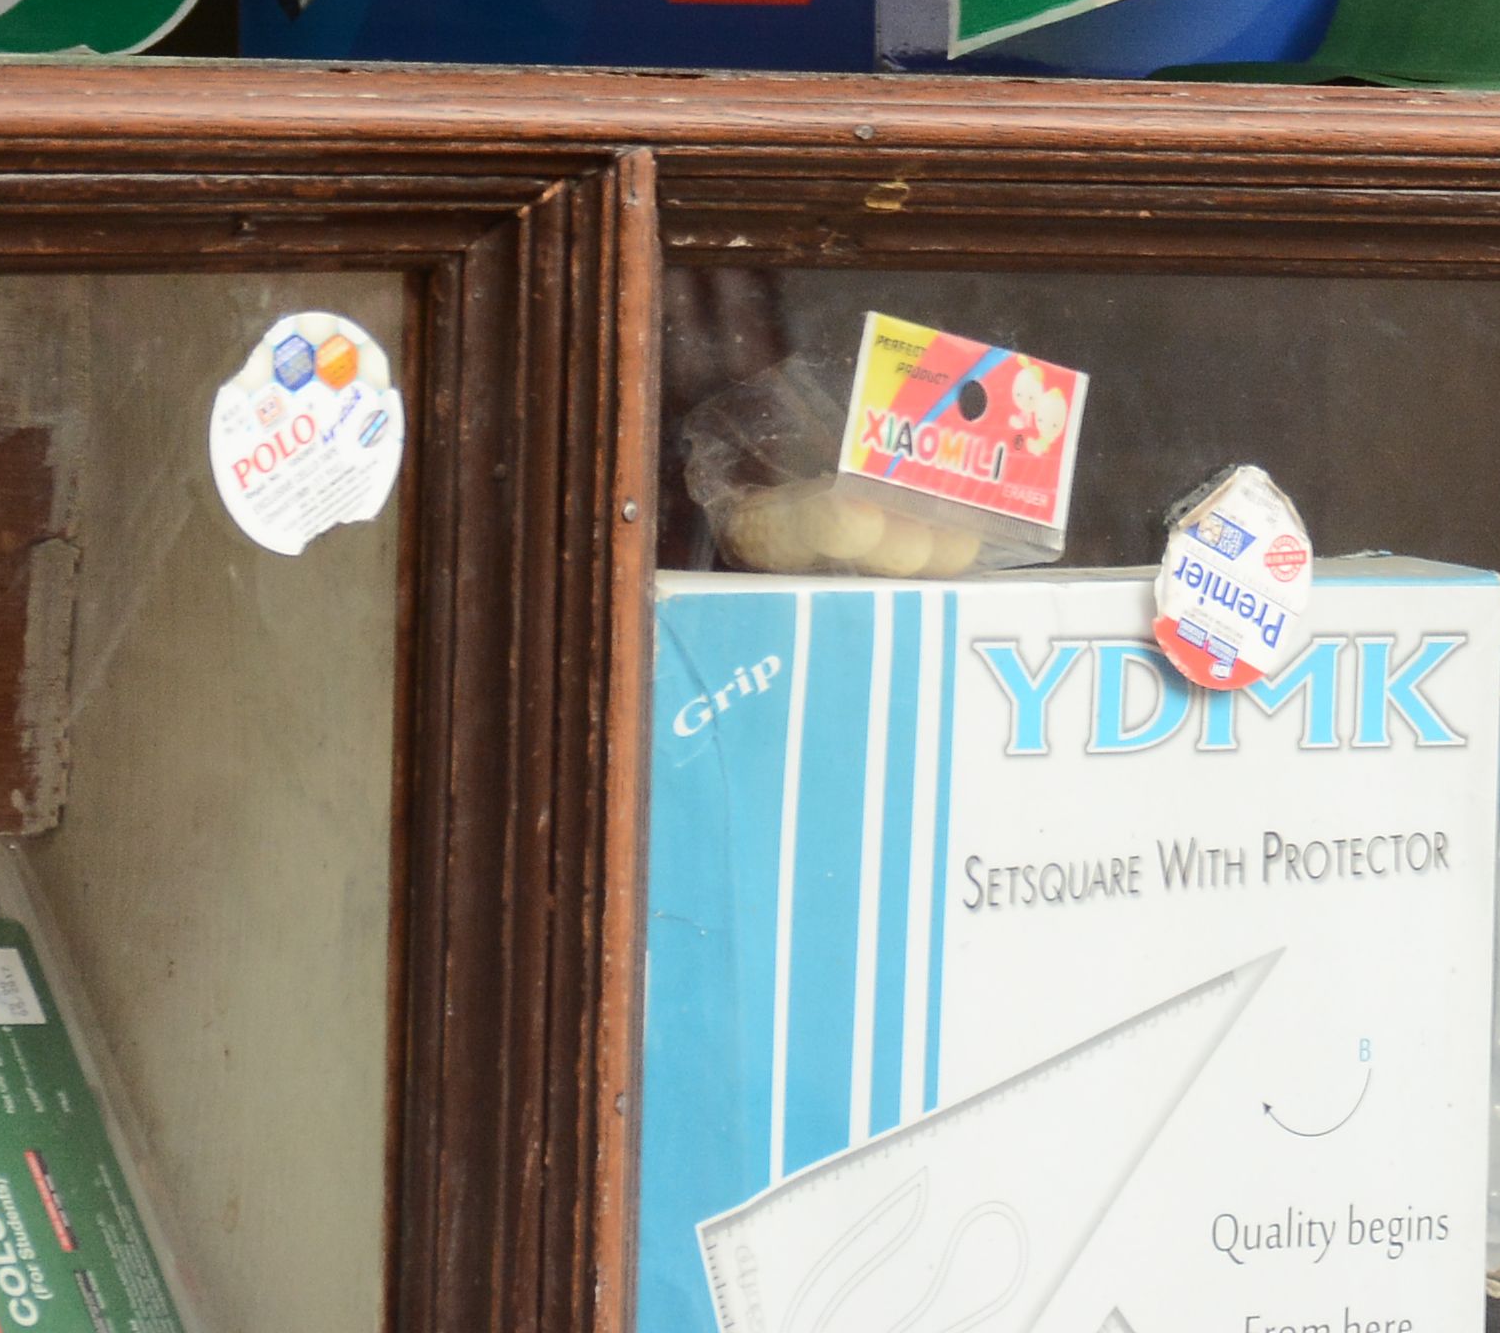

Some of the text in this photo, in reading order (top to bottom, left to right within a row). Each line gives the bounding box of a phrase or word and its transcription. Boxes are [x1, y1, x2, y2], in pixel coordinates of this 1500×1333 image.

[230, 413, 318, 492] POLO
[861, 407, 1007, 483] XIAOMILI
[1172, 554, 1287, 650] Premier
[670, 647, 785, 745] Grip
[1210, 1202, 1451, 1267] Quality begins
